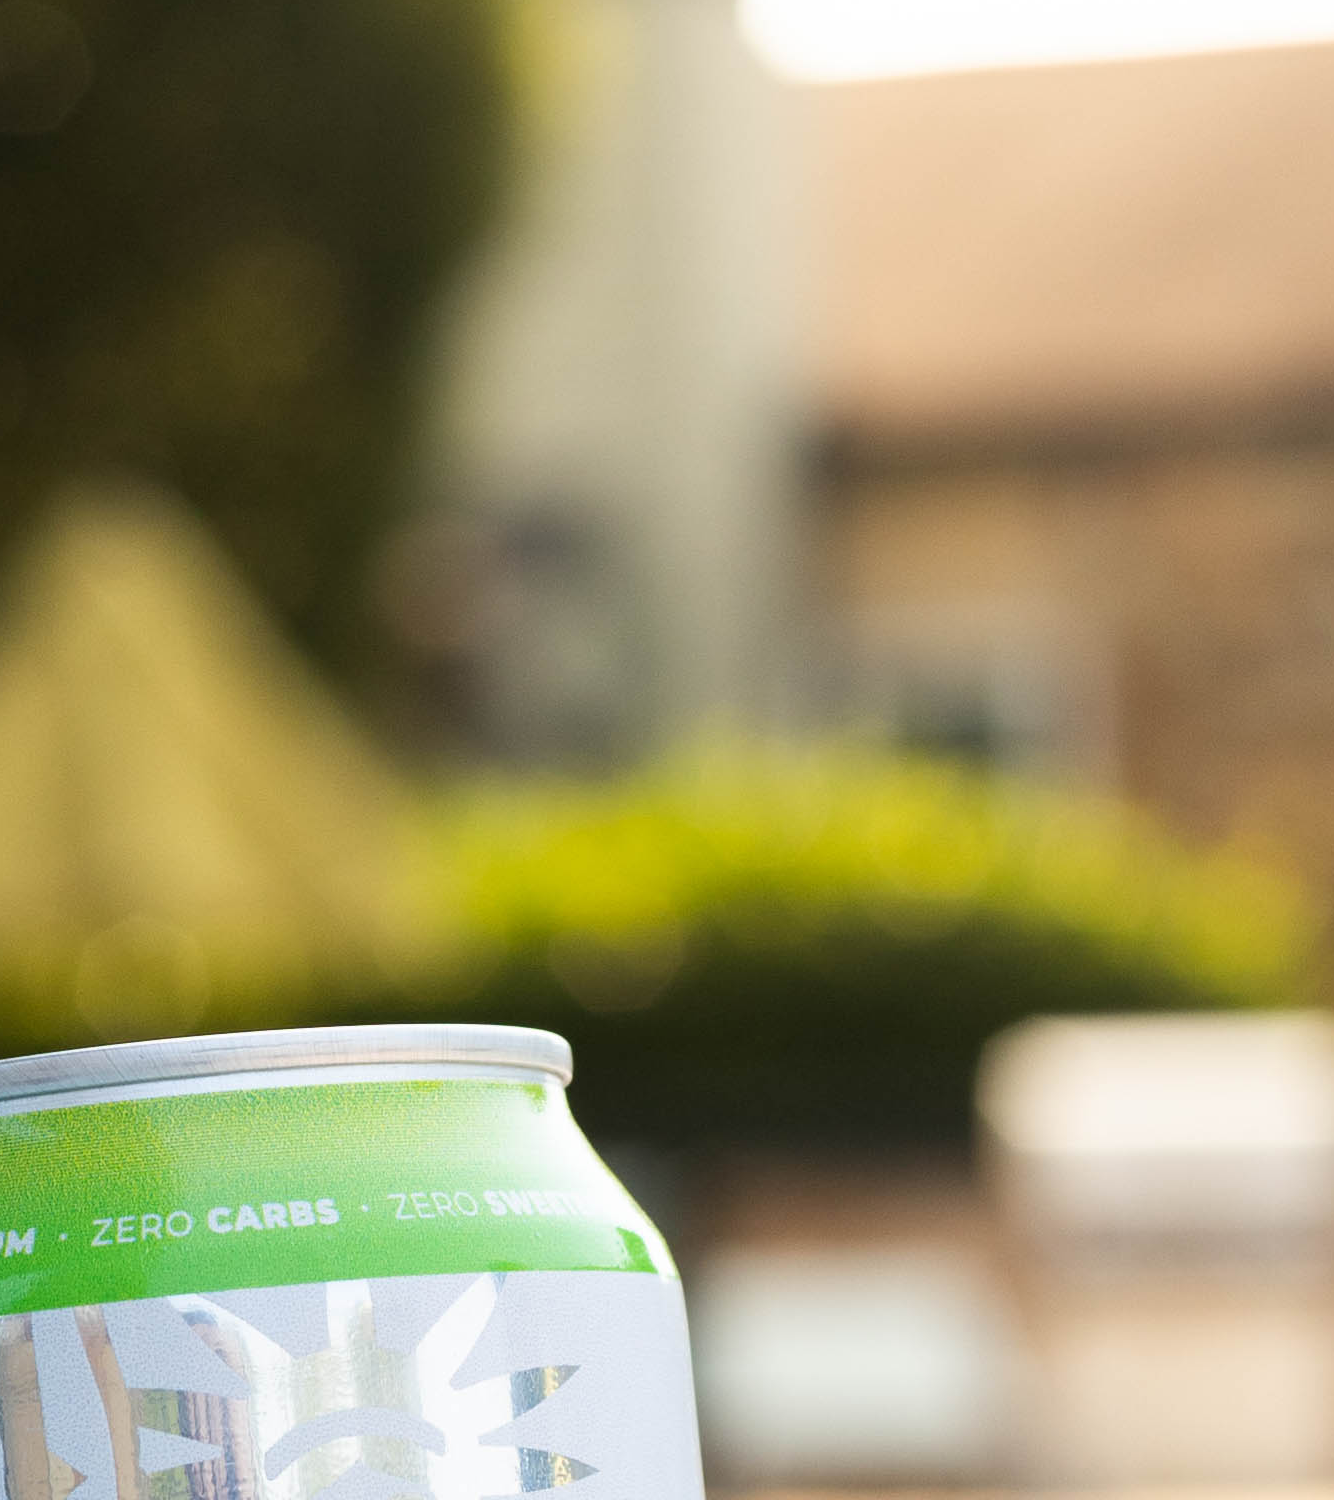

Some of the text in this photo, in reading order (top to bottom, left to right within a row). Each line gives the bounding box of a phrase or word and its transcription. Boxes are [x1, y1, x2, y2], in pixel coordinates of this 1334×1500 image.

[91, 1210, 194, 1247] ZERO
[208, 1198, 340, 1234] CARBS
[387, 1191, 479, 1220] ZERO
